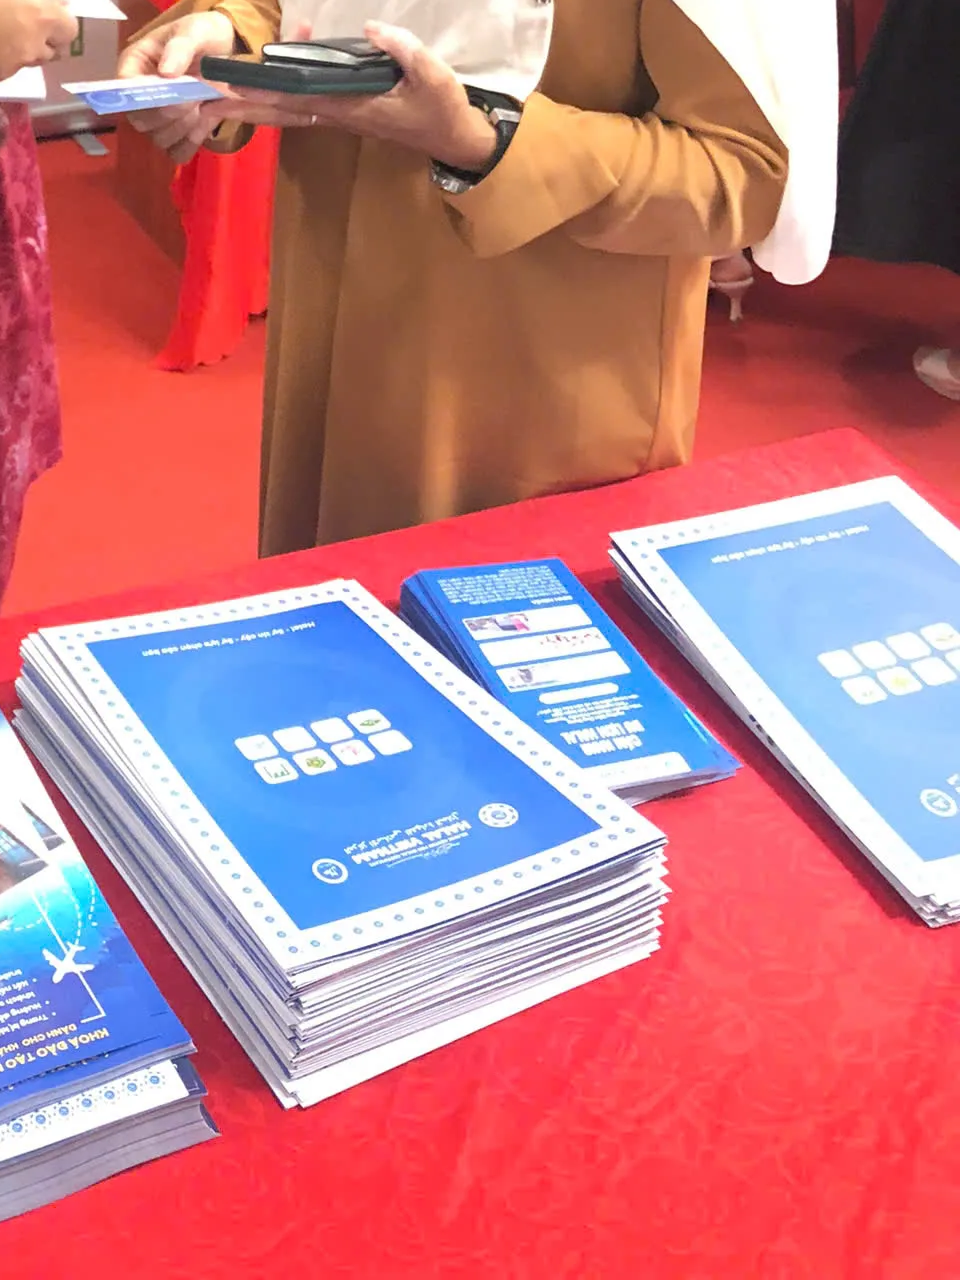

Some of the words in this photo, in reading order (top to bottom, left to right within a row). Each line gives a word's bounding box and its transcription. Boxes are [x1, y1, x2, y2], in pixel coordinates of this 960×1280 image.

[21, 1033, 46, 1046] CHO
[67, 1028, 109, 1049] KHOÁ
[36, 1040, 68, 1057] ĐÀO
[5, 1052, 36, 1068] TẠO
